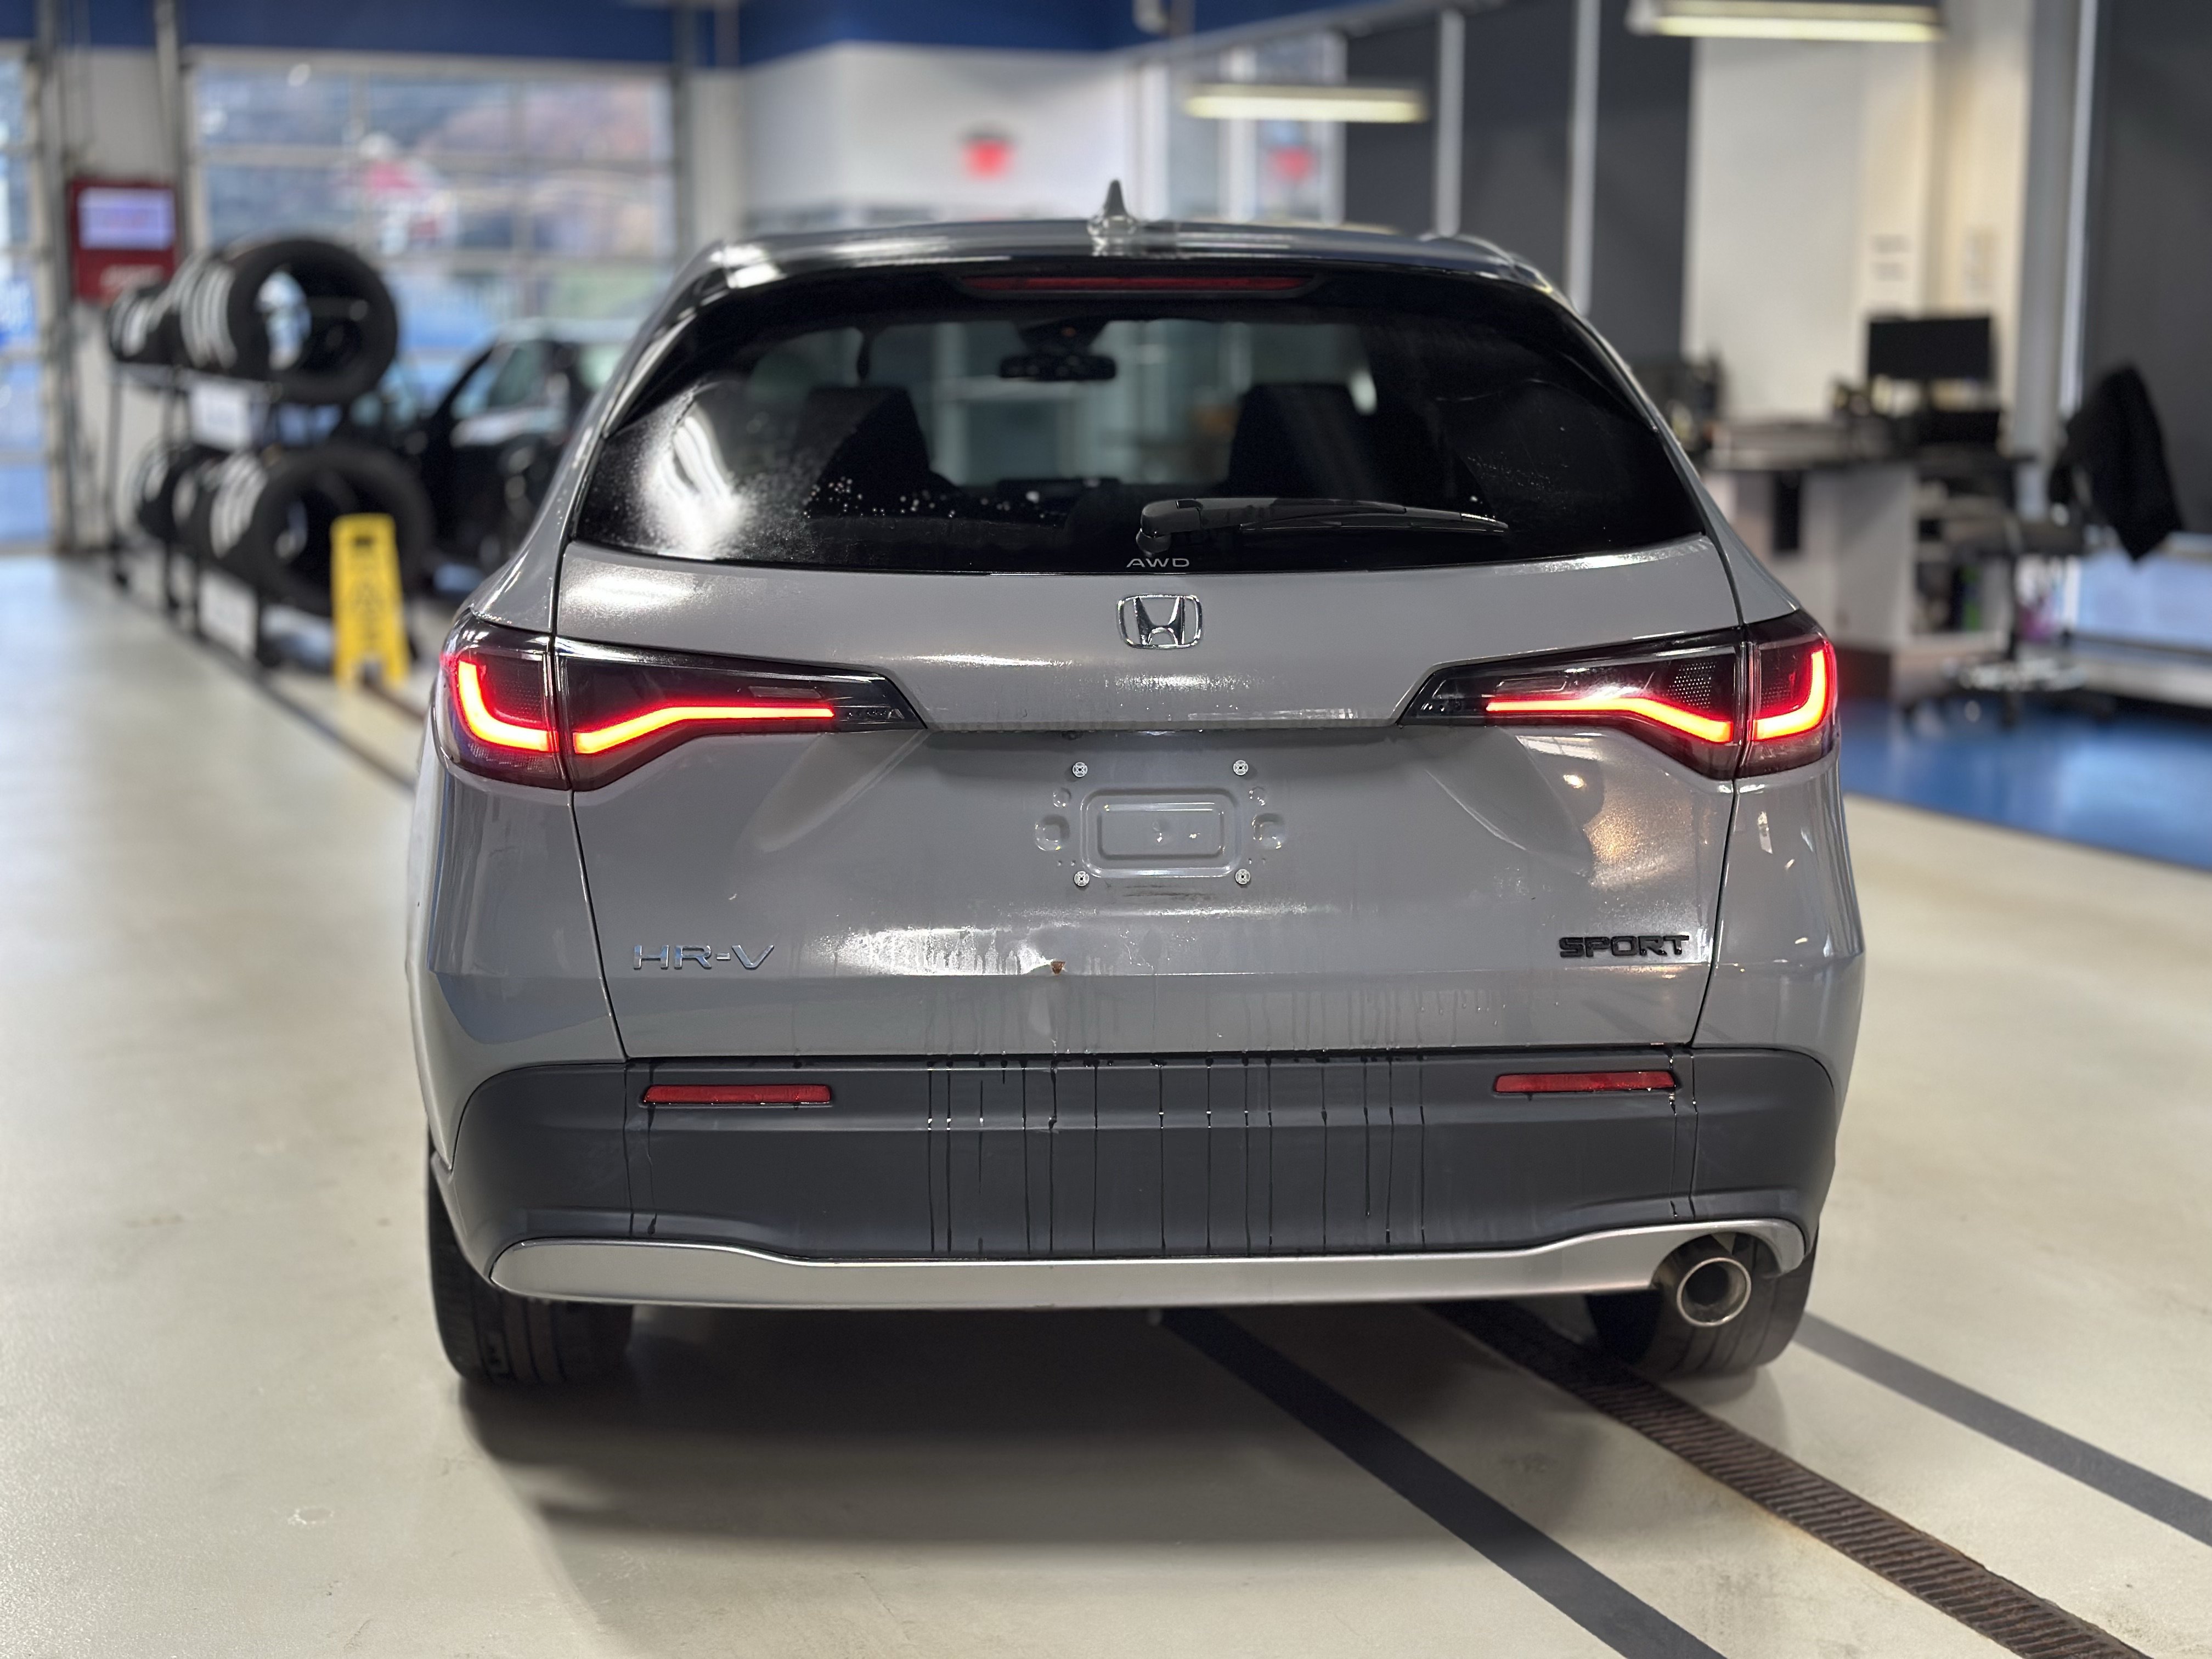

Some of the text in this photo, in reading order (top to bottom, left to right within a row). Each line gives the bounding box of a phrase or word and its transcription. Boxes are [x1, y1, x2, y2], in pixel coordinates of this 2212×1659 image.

[1126, 557, 1190, 568] AWD
[633, 945, 774, 970] HR-V
[1559, 935, 1690, 958] SPORT
